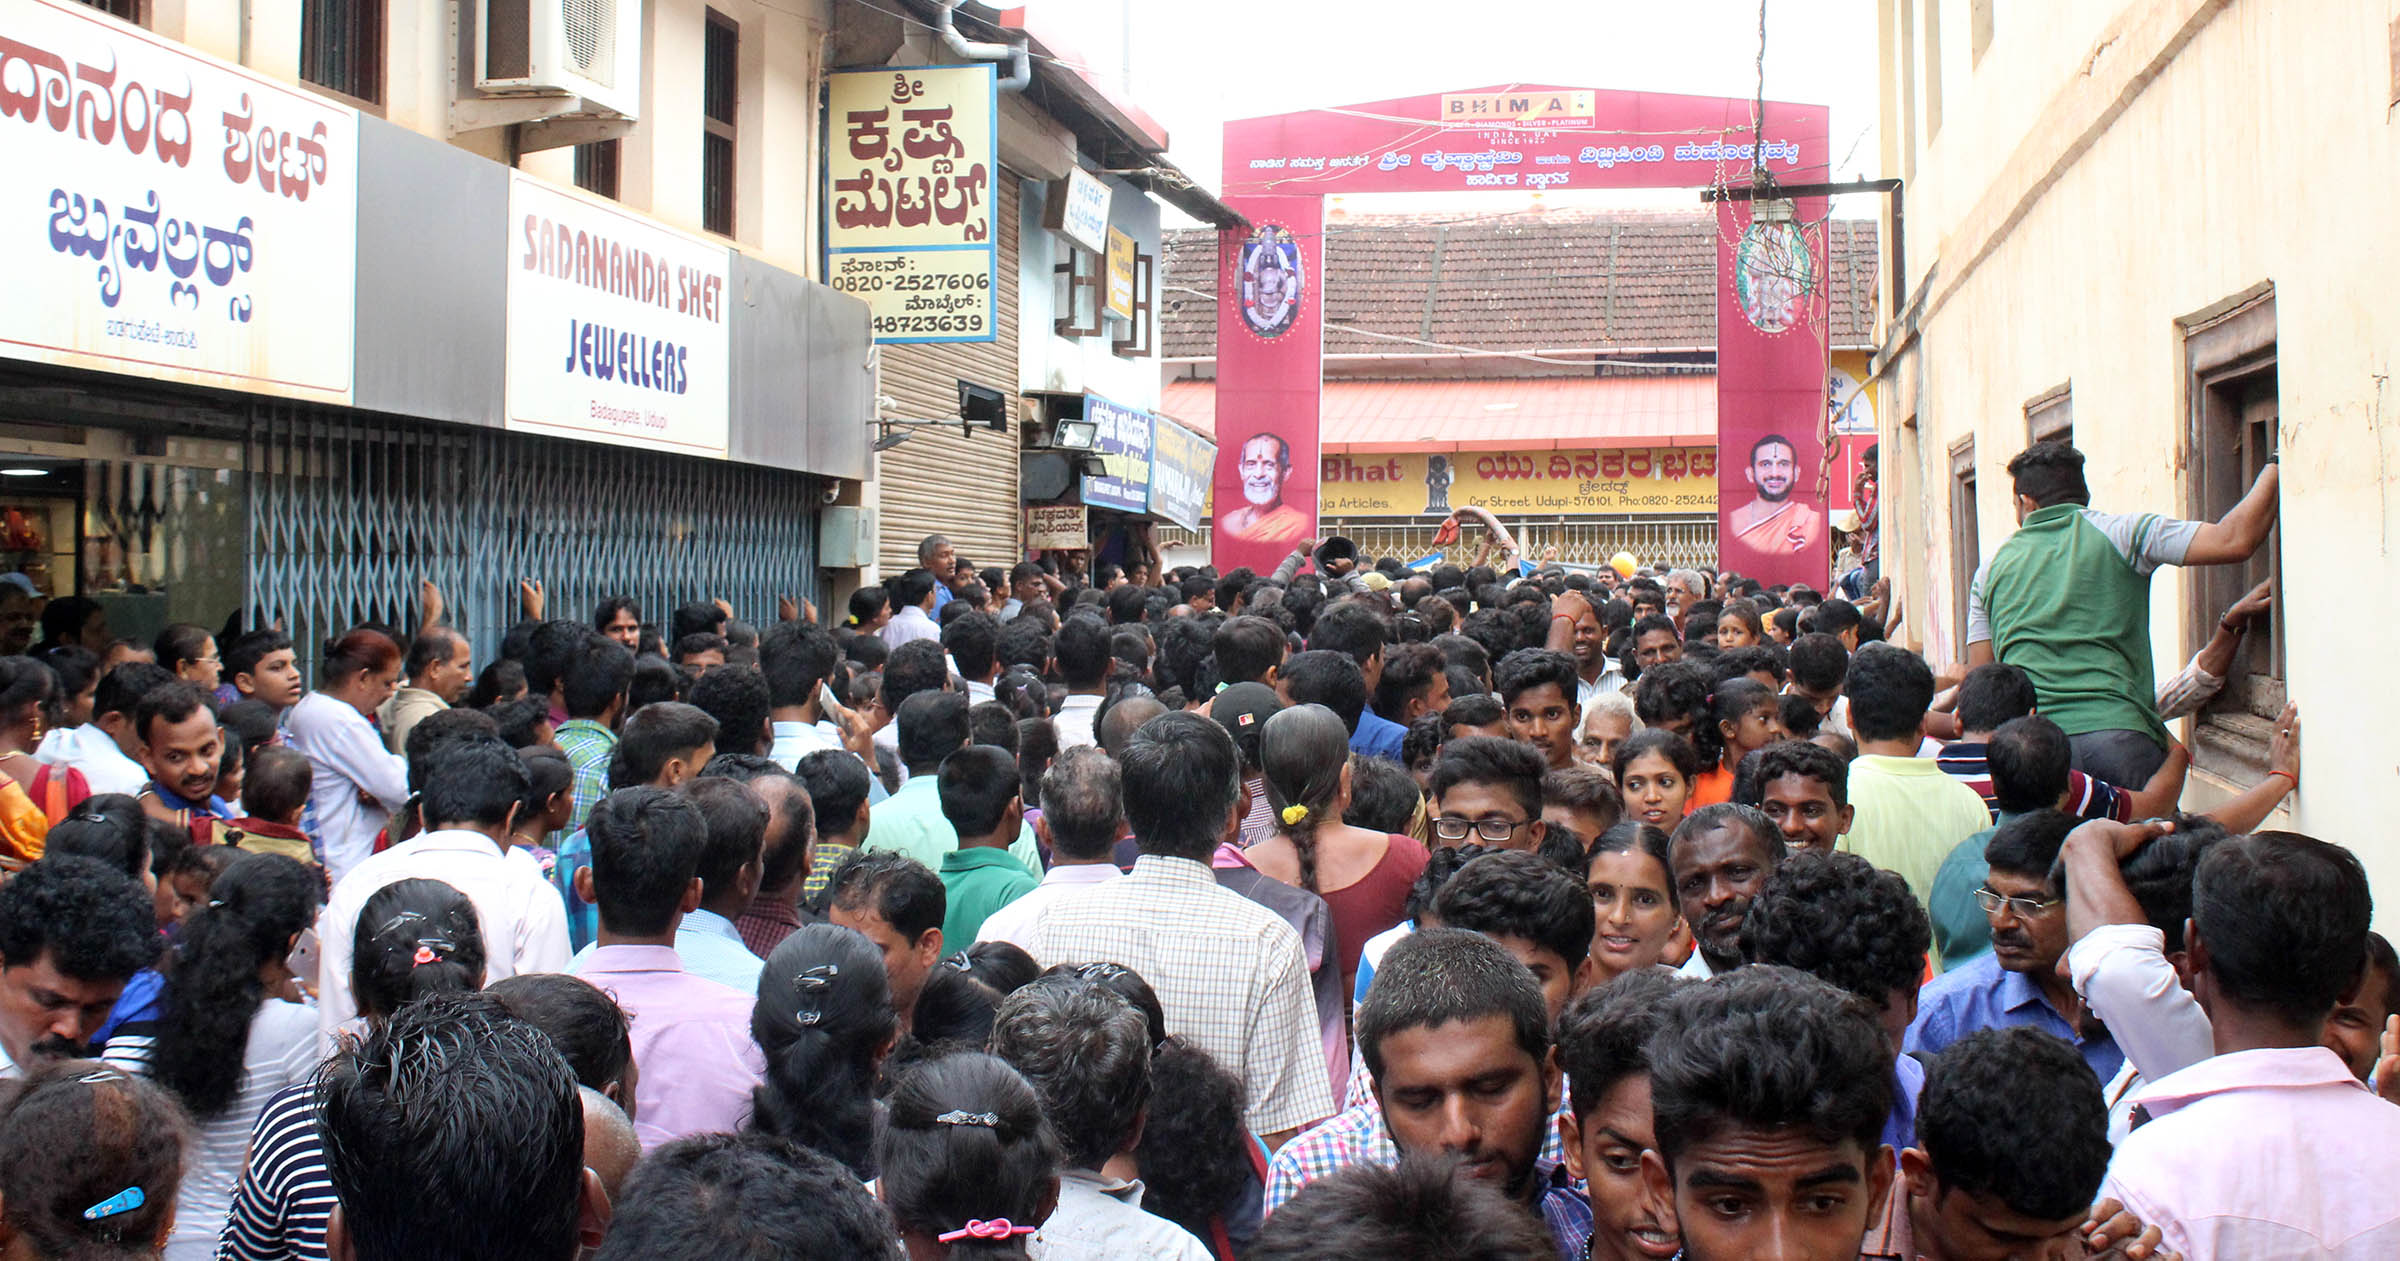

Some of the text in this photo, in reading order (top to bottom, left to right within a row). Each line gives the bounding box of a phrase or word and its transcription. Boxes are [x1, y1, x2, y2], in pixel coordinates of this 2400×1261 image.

[891, 73, 924, 104] ಶ್ರೀ
[1450, 97, 1563, 113] BHIMA
[1474, 120, 1516, 128] DIAMONDS
[1522, 119, 1546, 127] SILVER
[1551, 118, 1588, 126] PLATINUM
[847, 104, 965, 174] ಕೃಷ್ಣ
[1477, 130, 1558, 139] INDIA UAE
[1490, 137, 1519, 145] SINCE
[222, 93, 327, 202] ಶೇಟ್
[1377, 151, 1410, 171] ಶ್ರೀ
[1421, 149, 1523, 171] ಕೃಷ್ಣಾಷ್ಟಮಿ
[1466, 171, 1570, 189] ಹಾರ್ದಿಕ ಸ್ವಾಗತ
[835, 163, 987, 242] ಮೆಟಲ್ಸ್
[523, 214, 722, 323] SADANANDA SHET
[832, 273, 989, 292] 0820-2527606
[566, 319, 687, 395] JEWELLERS
[645, 408, 668, 431] Udupi
[1321, 457, 1403, 483] Bhat
[1477, 452, 1545, 480] ಯು.
[1548, 450, 1653, 480] ದಿನಕರ
[1339, 497, 1392, 510] Articles.
[1469, 496, 1488, 508] Car
